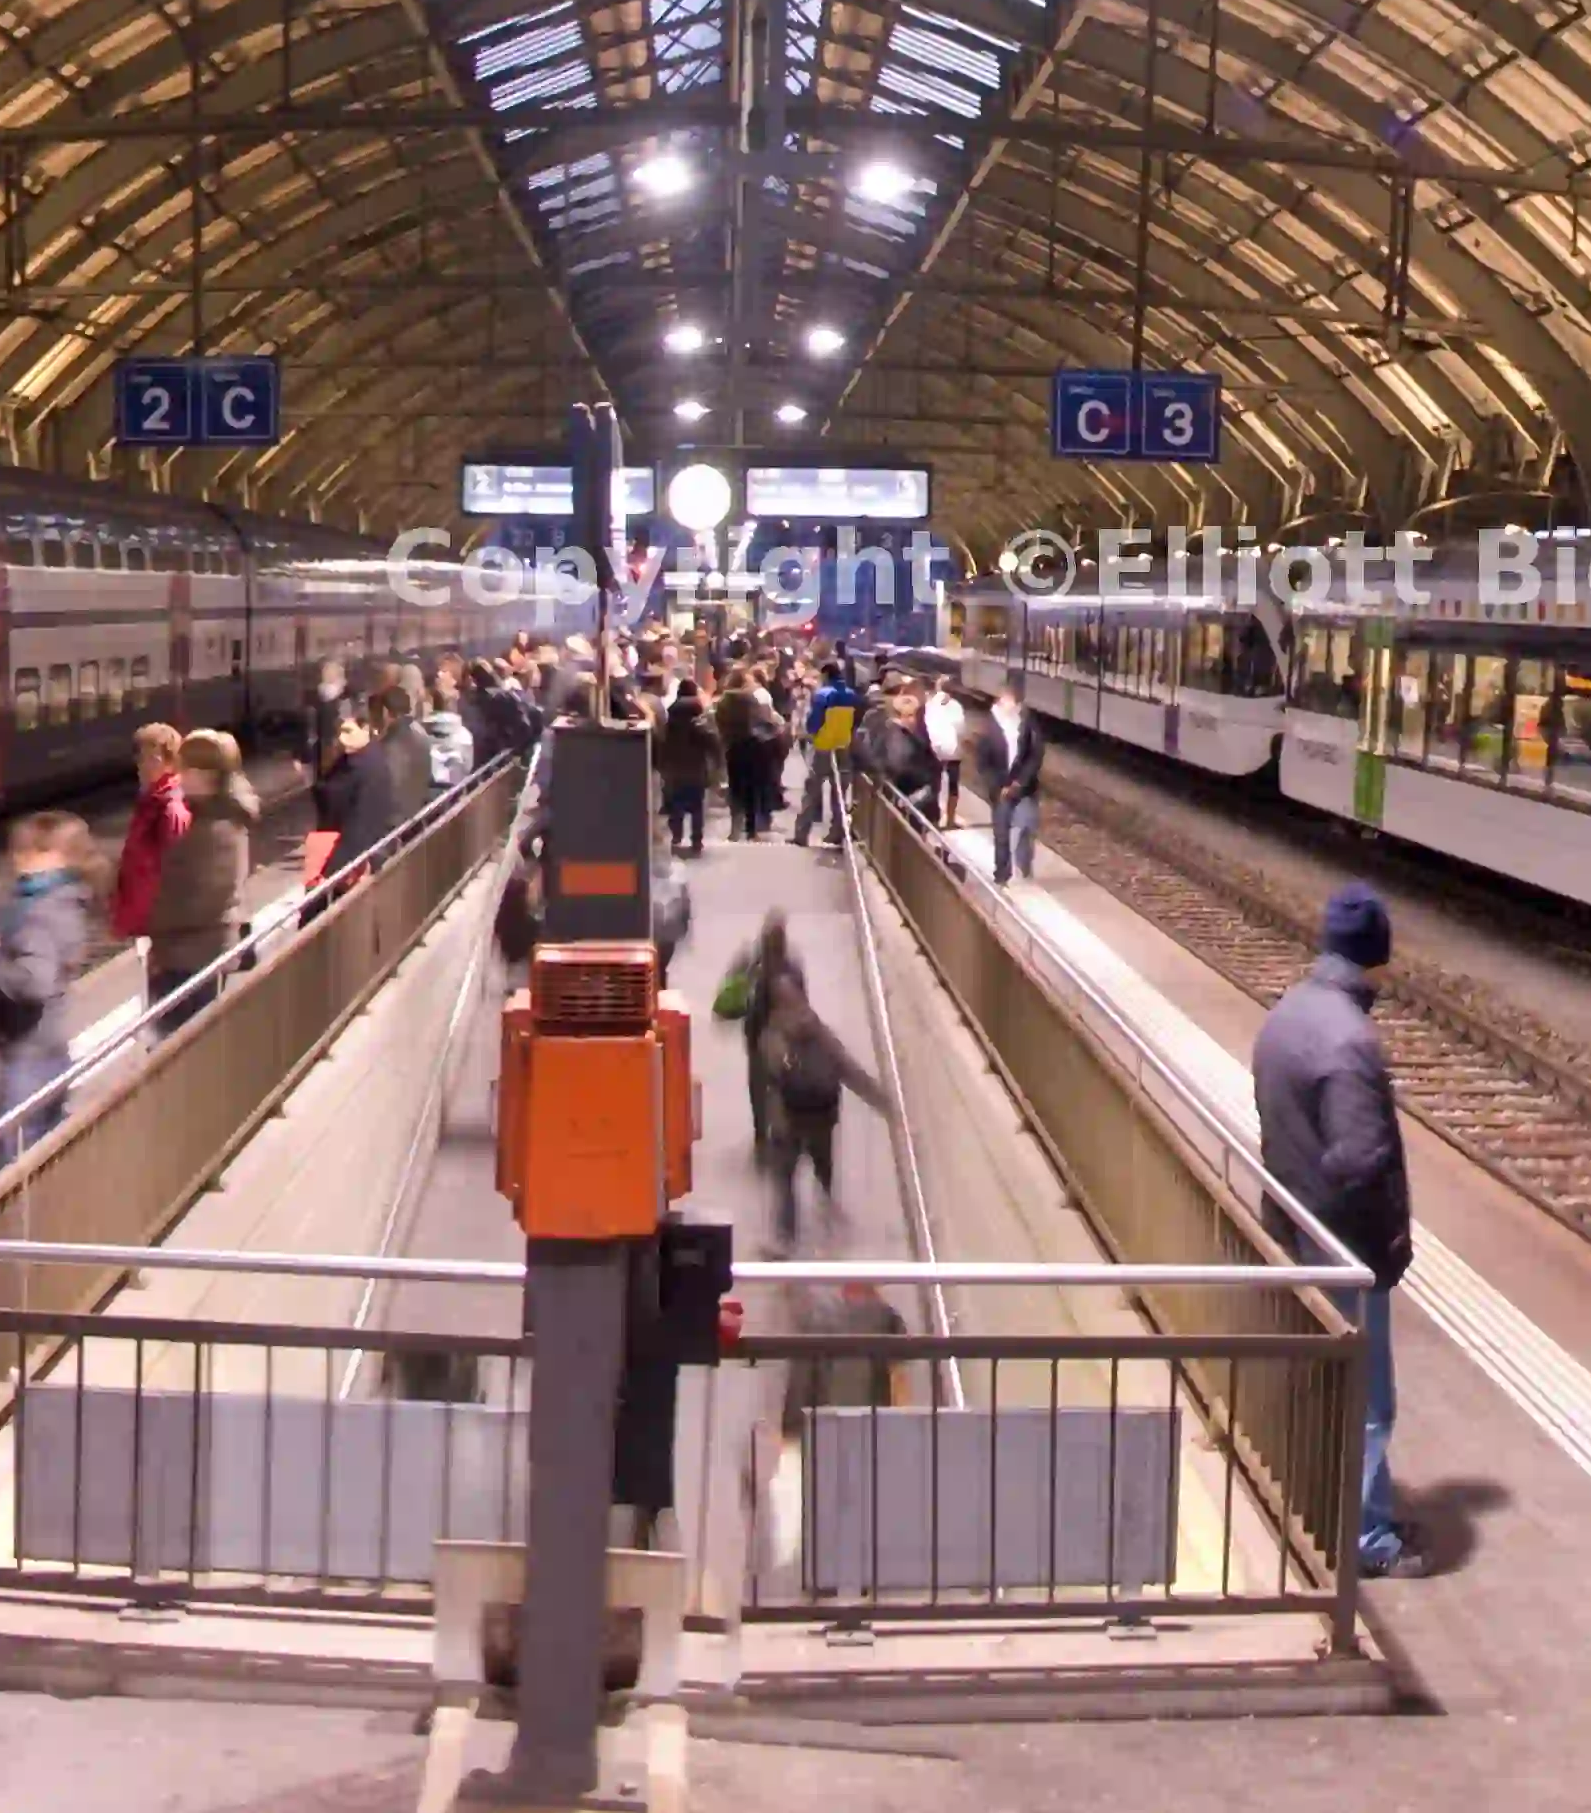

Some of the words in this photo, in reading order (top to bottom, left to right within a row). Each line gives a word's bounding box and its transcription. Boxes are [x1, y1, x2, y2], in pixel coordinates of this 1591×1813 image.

[141, 387, 170, 430] 2
[222, 386, 256, 429] C
[1077, 399, 1111, 443] C
[1162, 402, 1194, 446] 3
